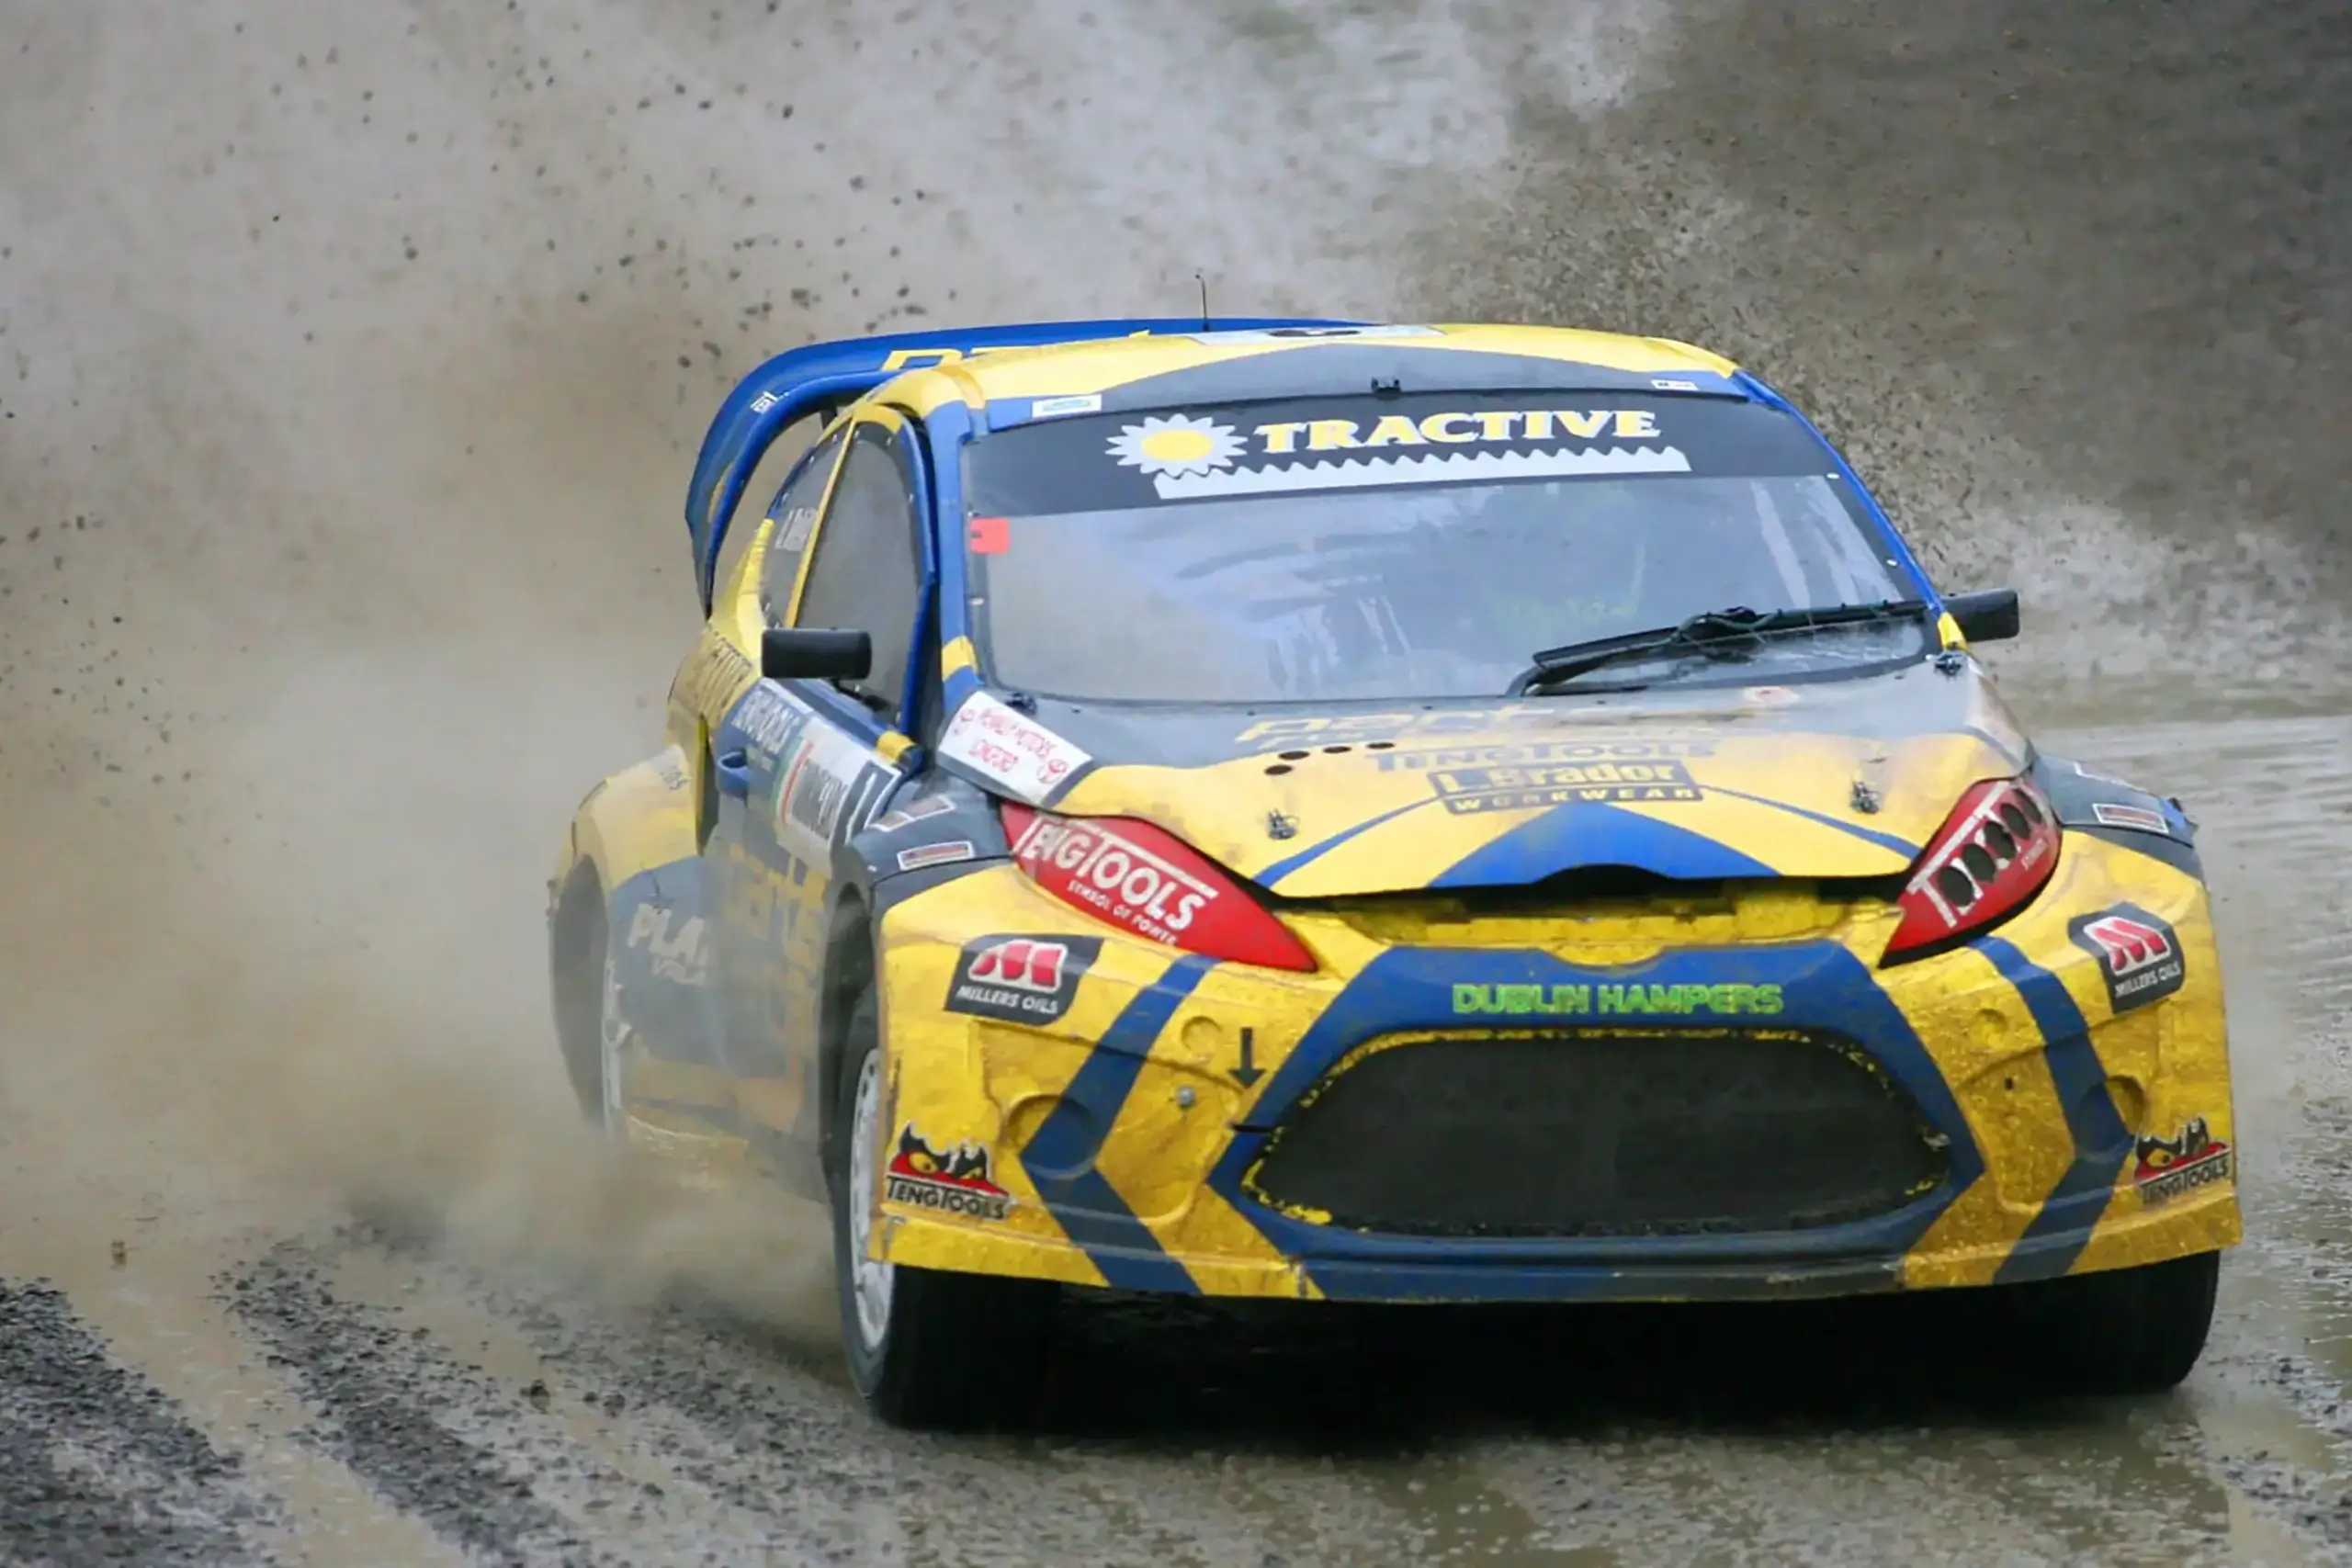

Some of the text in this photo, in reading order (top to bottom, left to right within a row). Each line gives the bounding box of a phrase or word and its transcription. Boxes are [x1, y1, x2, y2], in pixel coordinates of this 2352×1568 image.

[1254, 411, 1661, 453] TRACTIVE
[1453, 787, 1697, 813] WORKWEAR
[956, 985, 1059, 1014] MILLERS OILS
[1452, 984, 1785, 1015] DUBLIN HAMPERS
[887, 1175, 1007, 1221] TENGTOOLS
